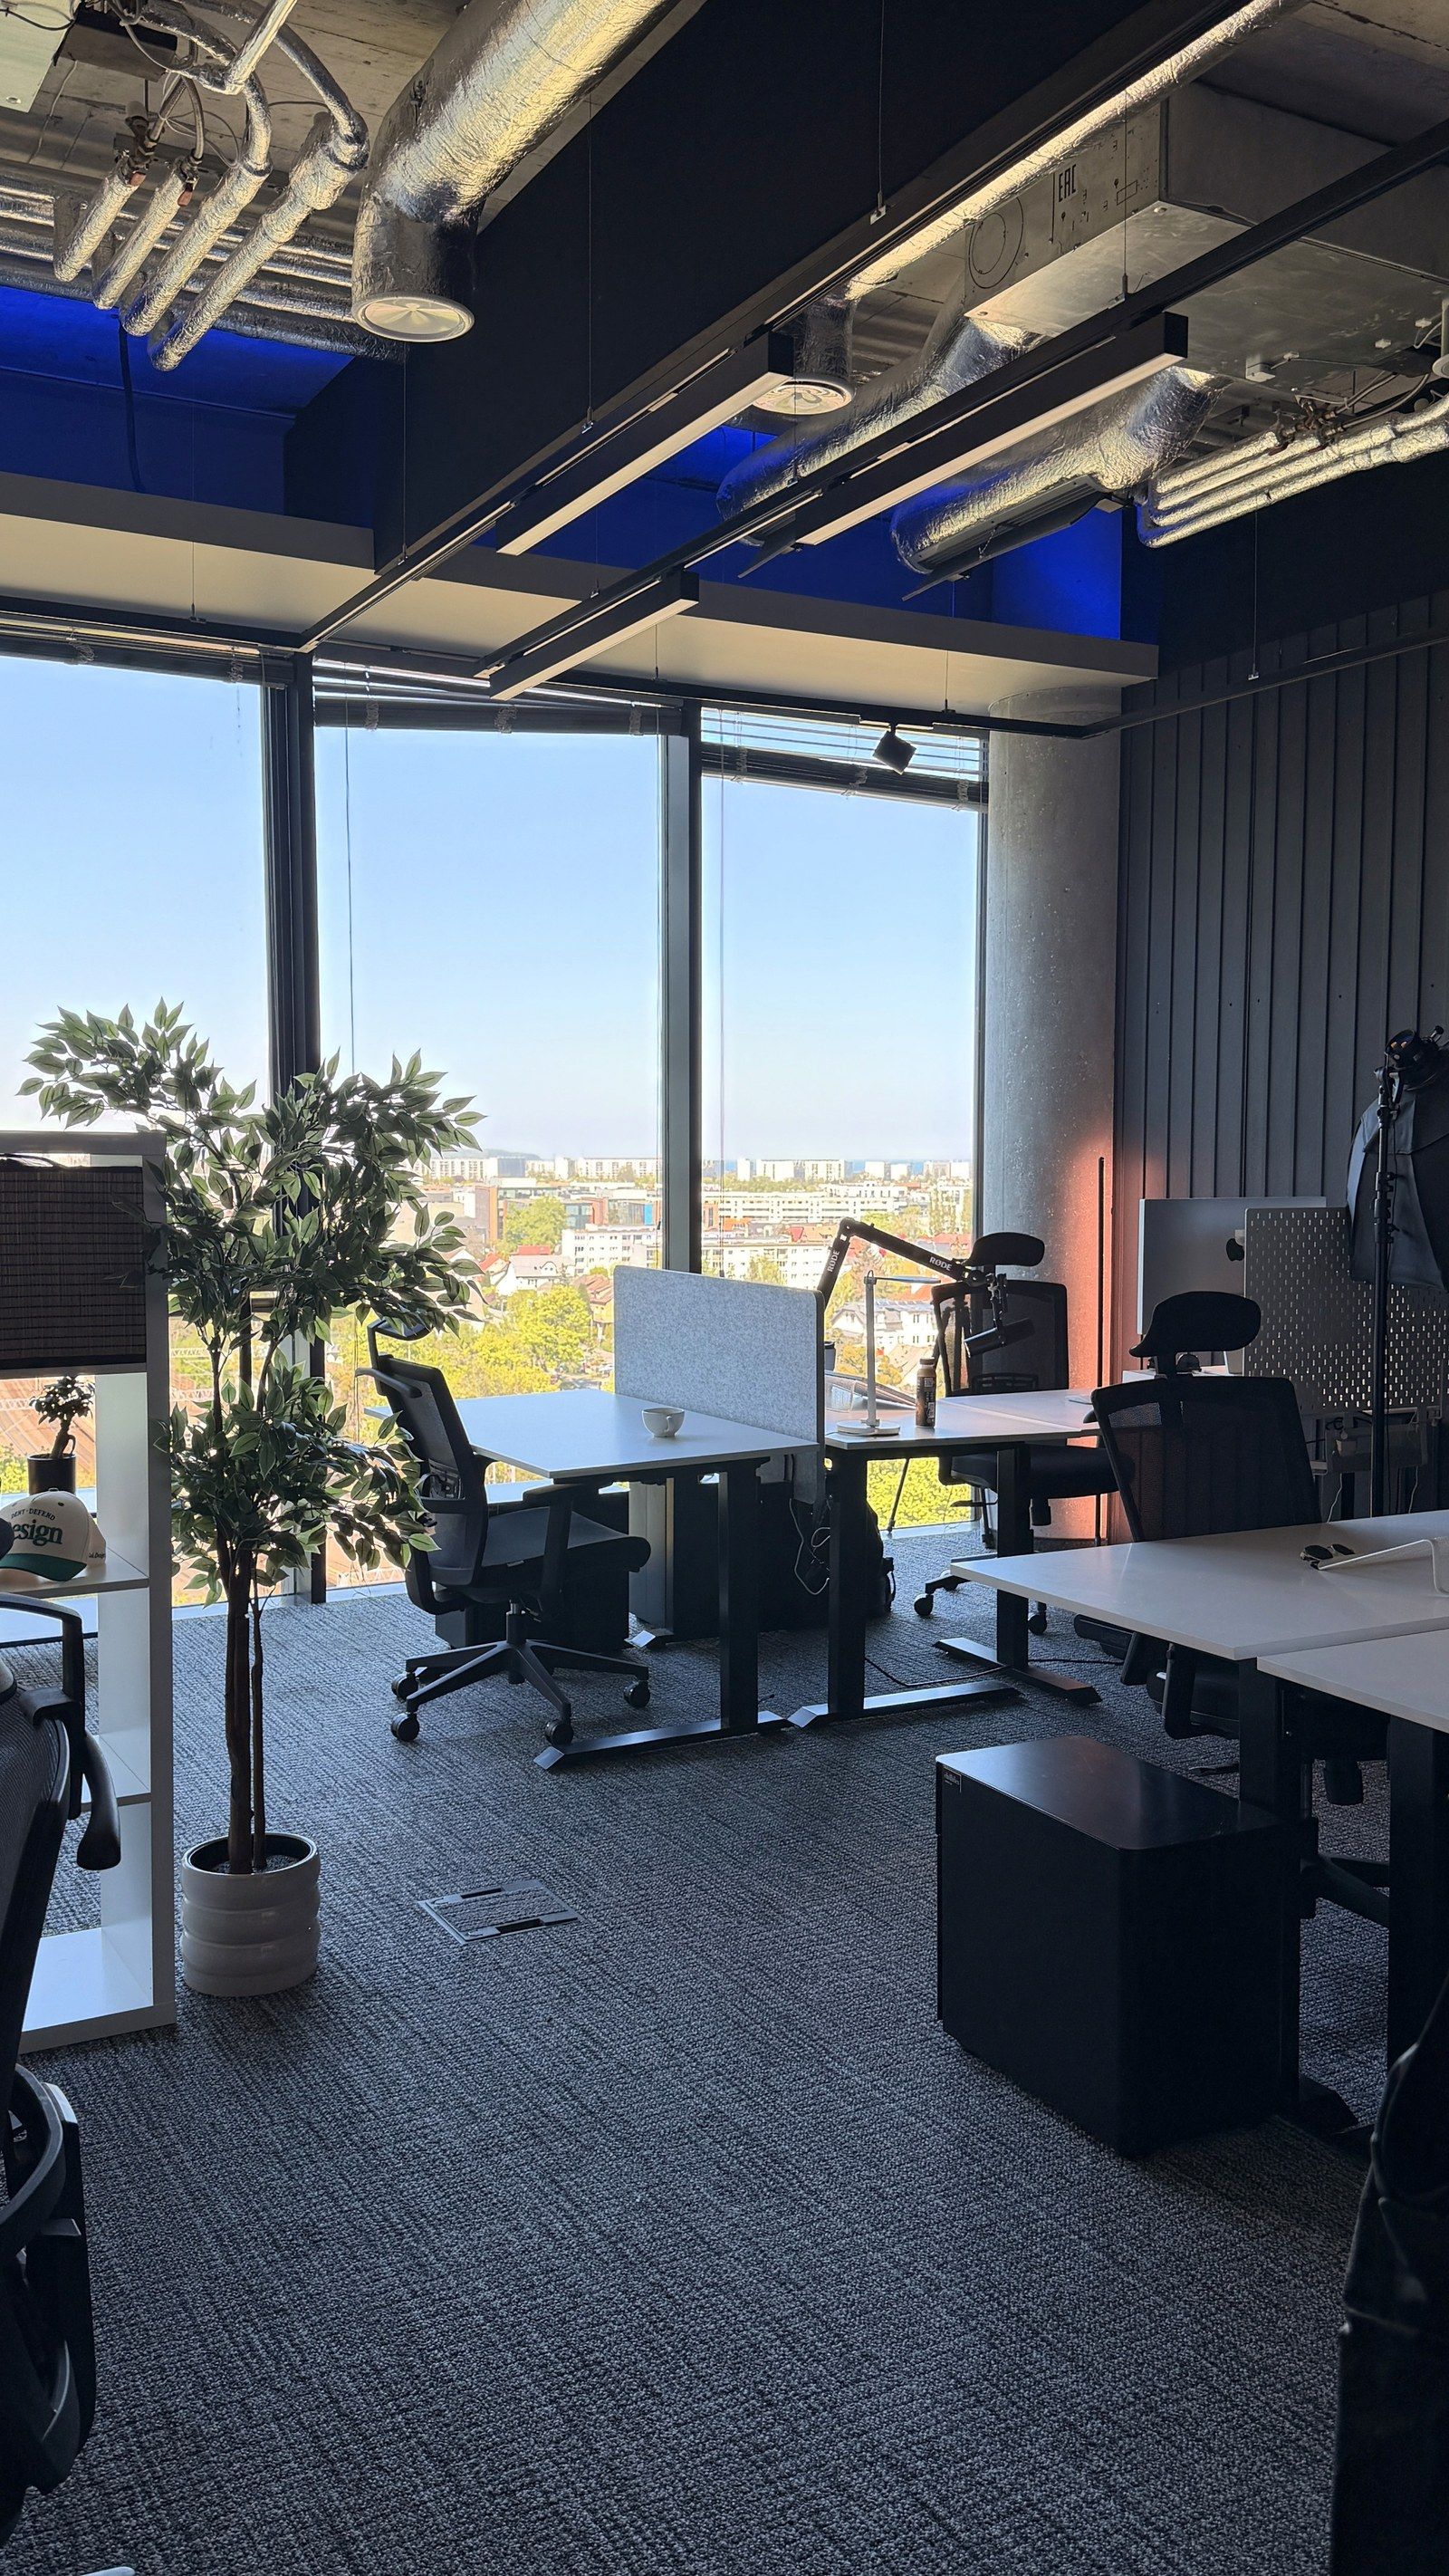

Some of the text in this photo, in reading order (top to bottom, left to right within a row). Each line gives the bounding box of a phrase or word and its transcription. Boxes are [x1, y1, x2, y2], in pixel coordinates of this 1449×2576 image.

[1059, 164, 1077, 203] EAC
[29, 1508, 56, 1521] DEFEND
[12, 1519, 63, 1547] esign
